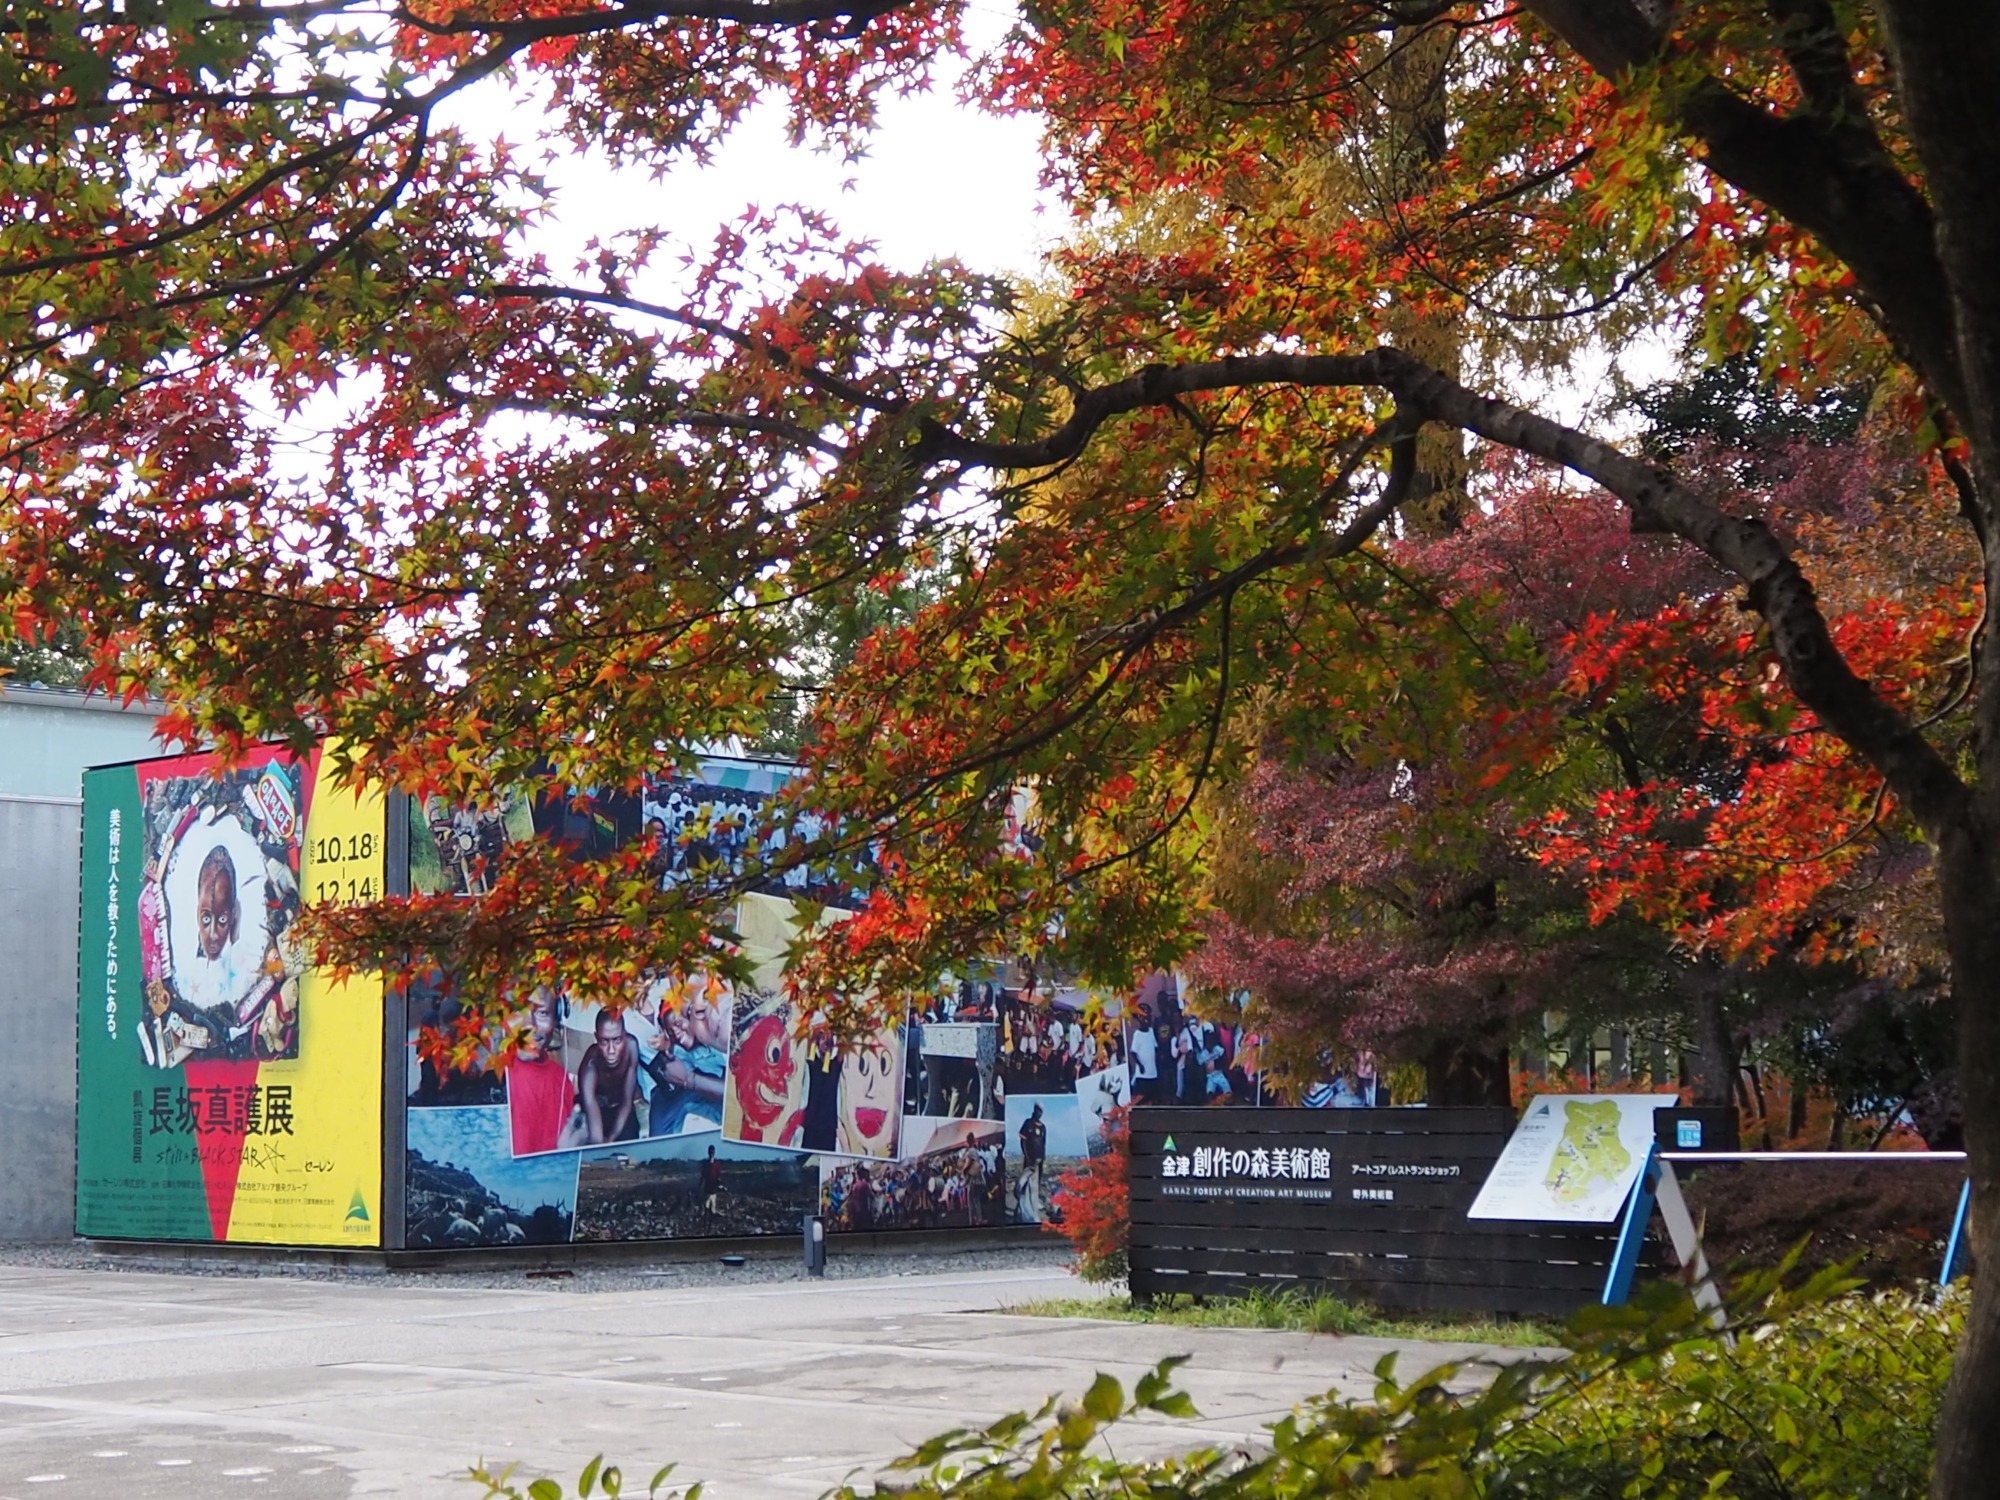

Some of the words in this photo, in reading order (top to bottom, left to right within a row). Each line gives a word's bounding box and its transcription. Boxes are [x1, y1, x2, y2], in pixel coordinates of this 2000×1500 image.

[261, 782, 292, 834] GARAGE
[317, 833, 372, 864] 10.18
[316, 876, 372, 908] 12.14
[106, 808, 121, 1040] 美術は人を救うためにある。
[148, 1084, 294, 1137] 長坂真護展
[305, 1160, 335, 1173] セーレン
[1162, 1147, 1331, 1179] 金津創作の森美術館
[1162, 1187, 1191, 1195] KANAZ
[1194, 1187, 1222, 1196] FOREST
[1224, 1188, 1234, 1196] of
[1236, 1188, 1276, 1197] CREATION
[1278, 1189, 1294, 1197] ART
[1296, 1190, 1332, 1199] MUSEUM
